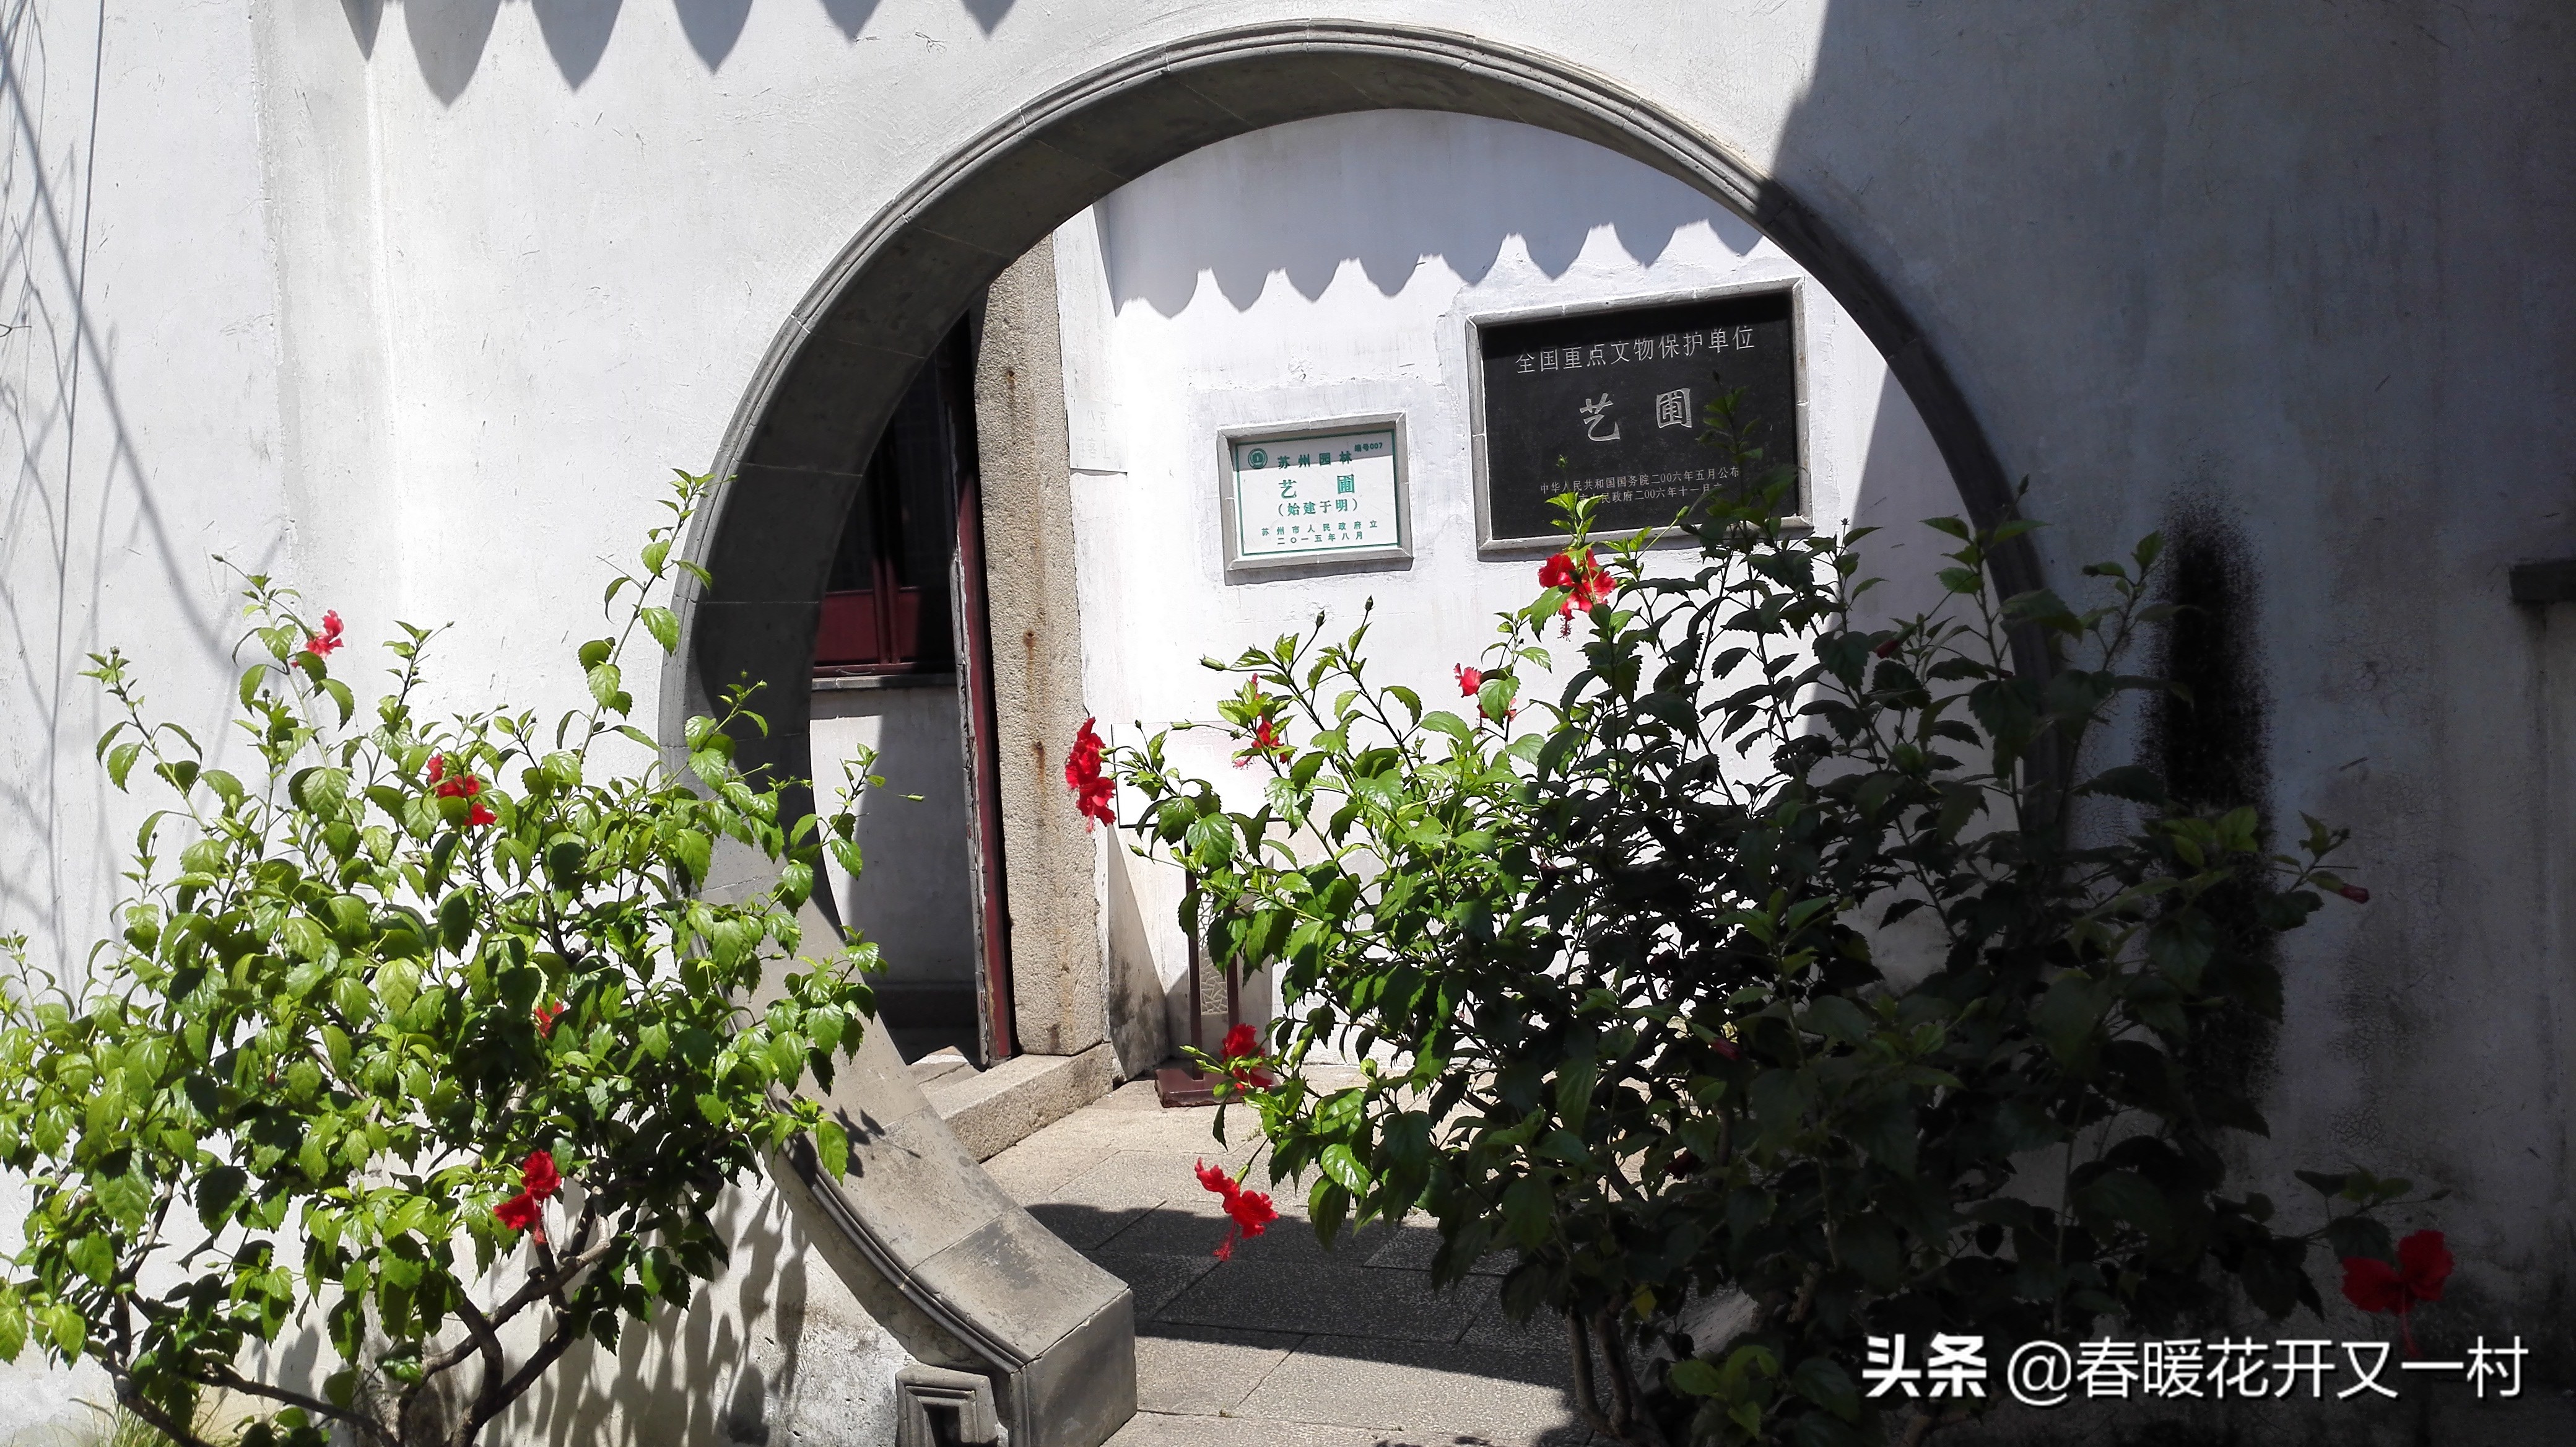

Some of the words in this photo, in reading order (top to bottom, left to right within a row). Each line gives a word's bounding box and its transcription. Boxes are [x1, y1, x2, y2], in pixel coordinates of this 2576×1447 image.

[1515, 325, 1756, 374] 全国重点文物保护单位
[1579, 387, 1693, 442] 艺圃
[1277, 450, 1352, 470] 苏州园林
[1279, 474, 1355, 499] 艺圃
[1278, 498, 1358, 517] （始建于明）
[1261, 520, 1378, 536] 苏州市人民政府立
